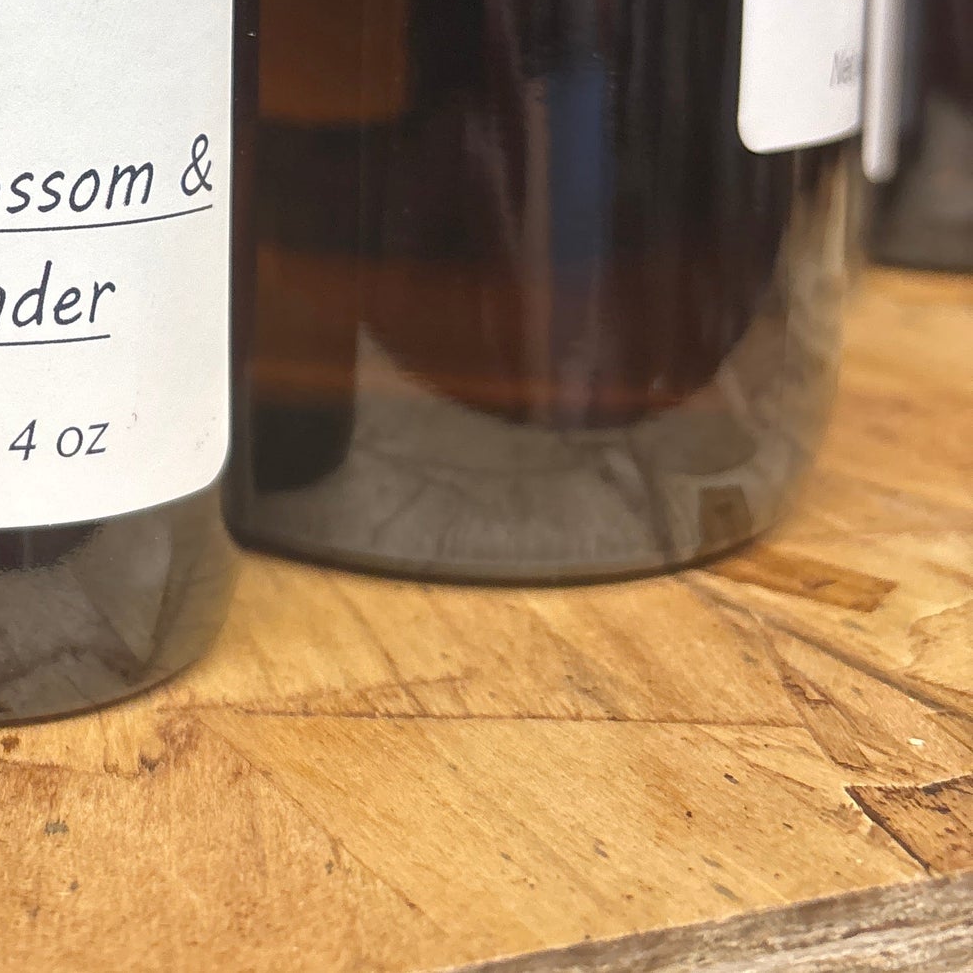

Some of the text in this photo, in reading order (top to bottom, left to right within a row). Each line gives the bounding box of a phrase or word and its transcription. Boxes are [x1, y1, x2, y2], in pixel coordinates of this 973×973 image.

[180, 133, 213, 196] &
[8, 420, 36, 461] 4
[56, 422, 109, 456] oz
